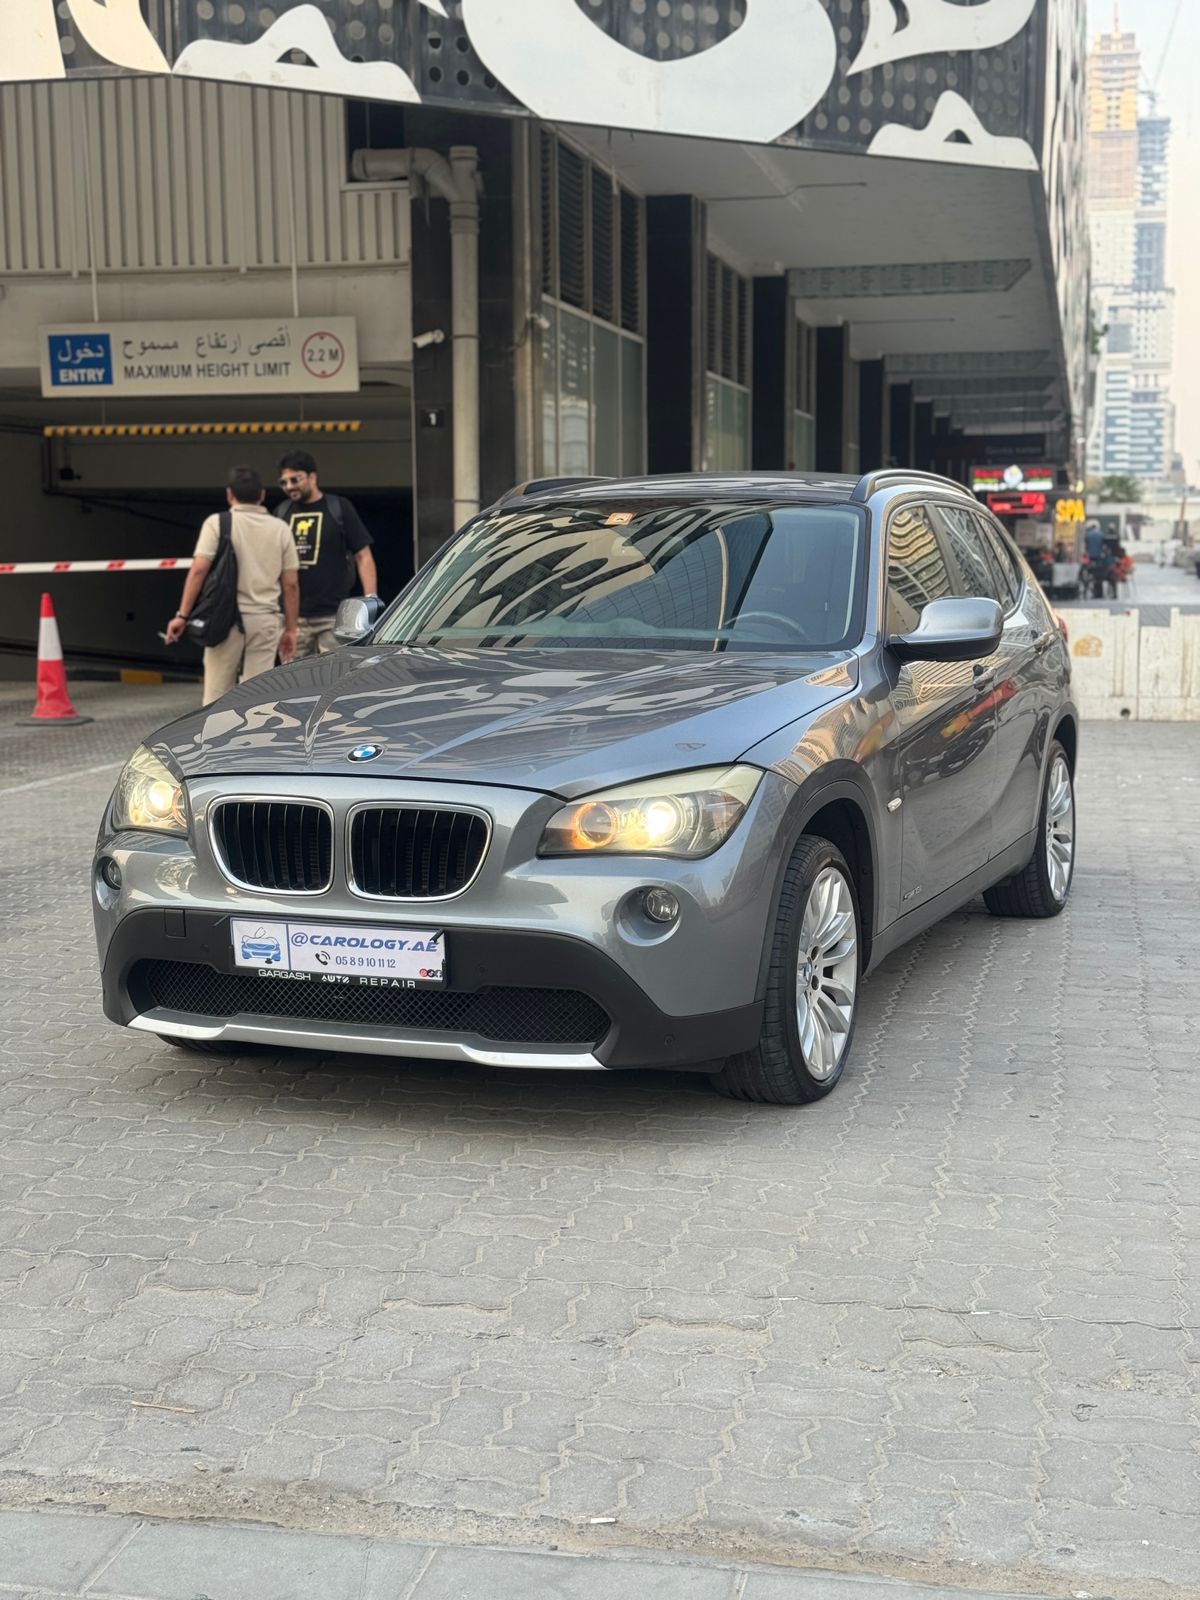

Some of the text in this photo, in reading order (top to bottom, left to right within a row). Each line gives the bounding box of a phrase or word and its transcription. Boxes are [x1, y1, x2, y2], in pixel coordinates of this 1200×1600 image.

[57, 339, 105, 364] دخول
[123, 339, 179, 360] مسموح
[196, 331, 241, 358] ارتفاع
[307, 348, 339, 362] 2.2 M
[58, 367, 106, 384] ENTRY
[123, 361, 291, 380] MAXIMUM HEIGHT LIMIT
[428, 412, 437, 426] 1
[1055, 498, 1085, 523] SPA
[291, 931, 439, 953] @CAROLOGY.AE
[258, 968, 312, 981] GARGASH
[359, 977, 416, 989] REPAIR
